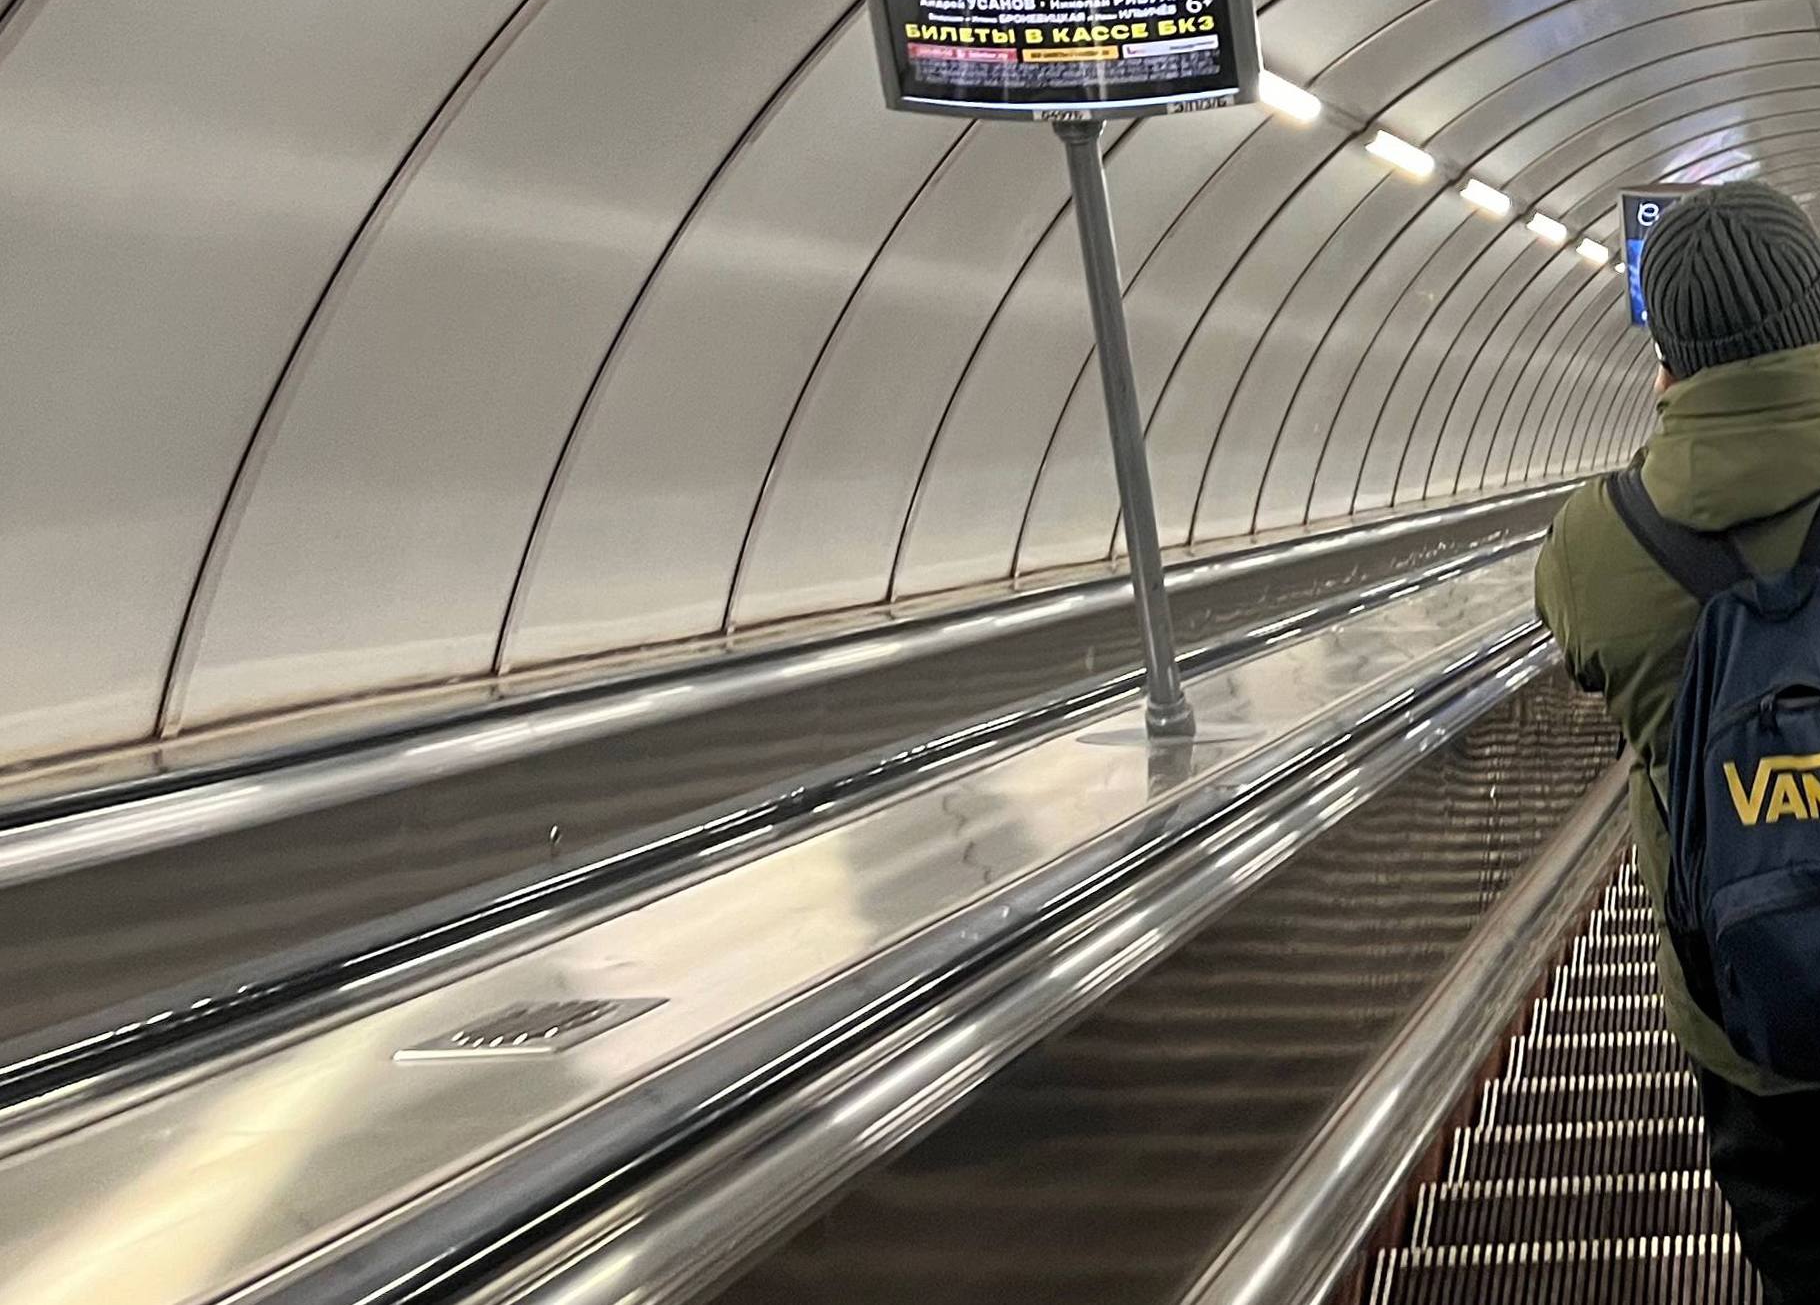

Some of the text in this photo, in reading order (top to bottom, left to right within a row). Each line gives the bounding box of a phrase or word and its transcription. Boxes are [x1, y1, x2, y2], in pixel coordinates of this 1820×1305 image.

[905, 15, 1216, 44] БИЛЕТЫ В КАССЕ БКЗ
